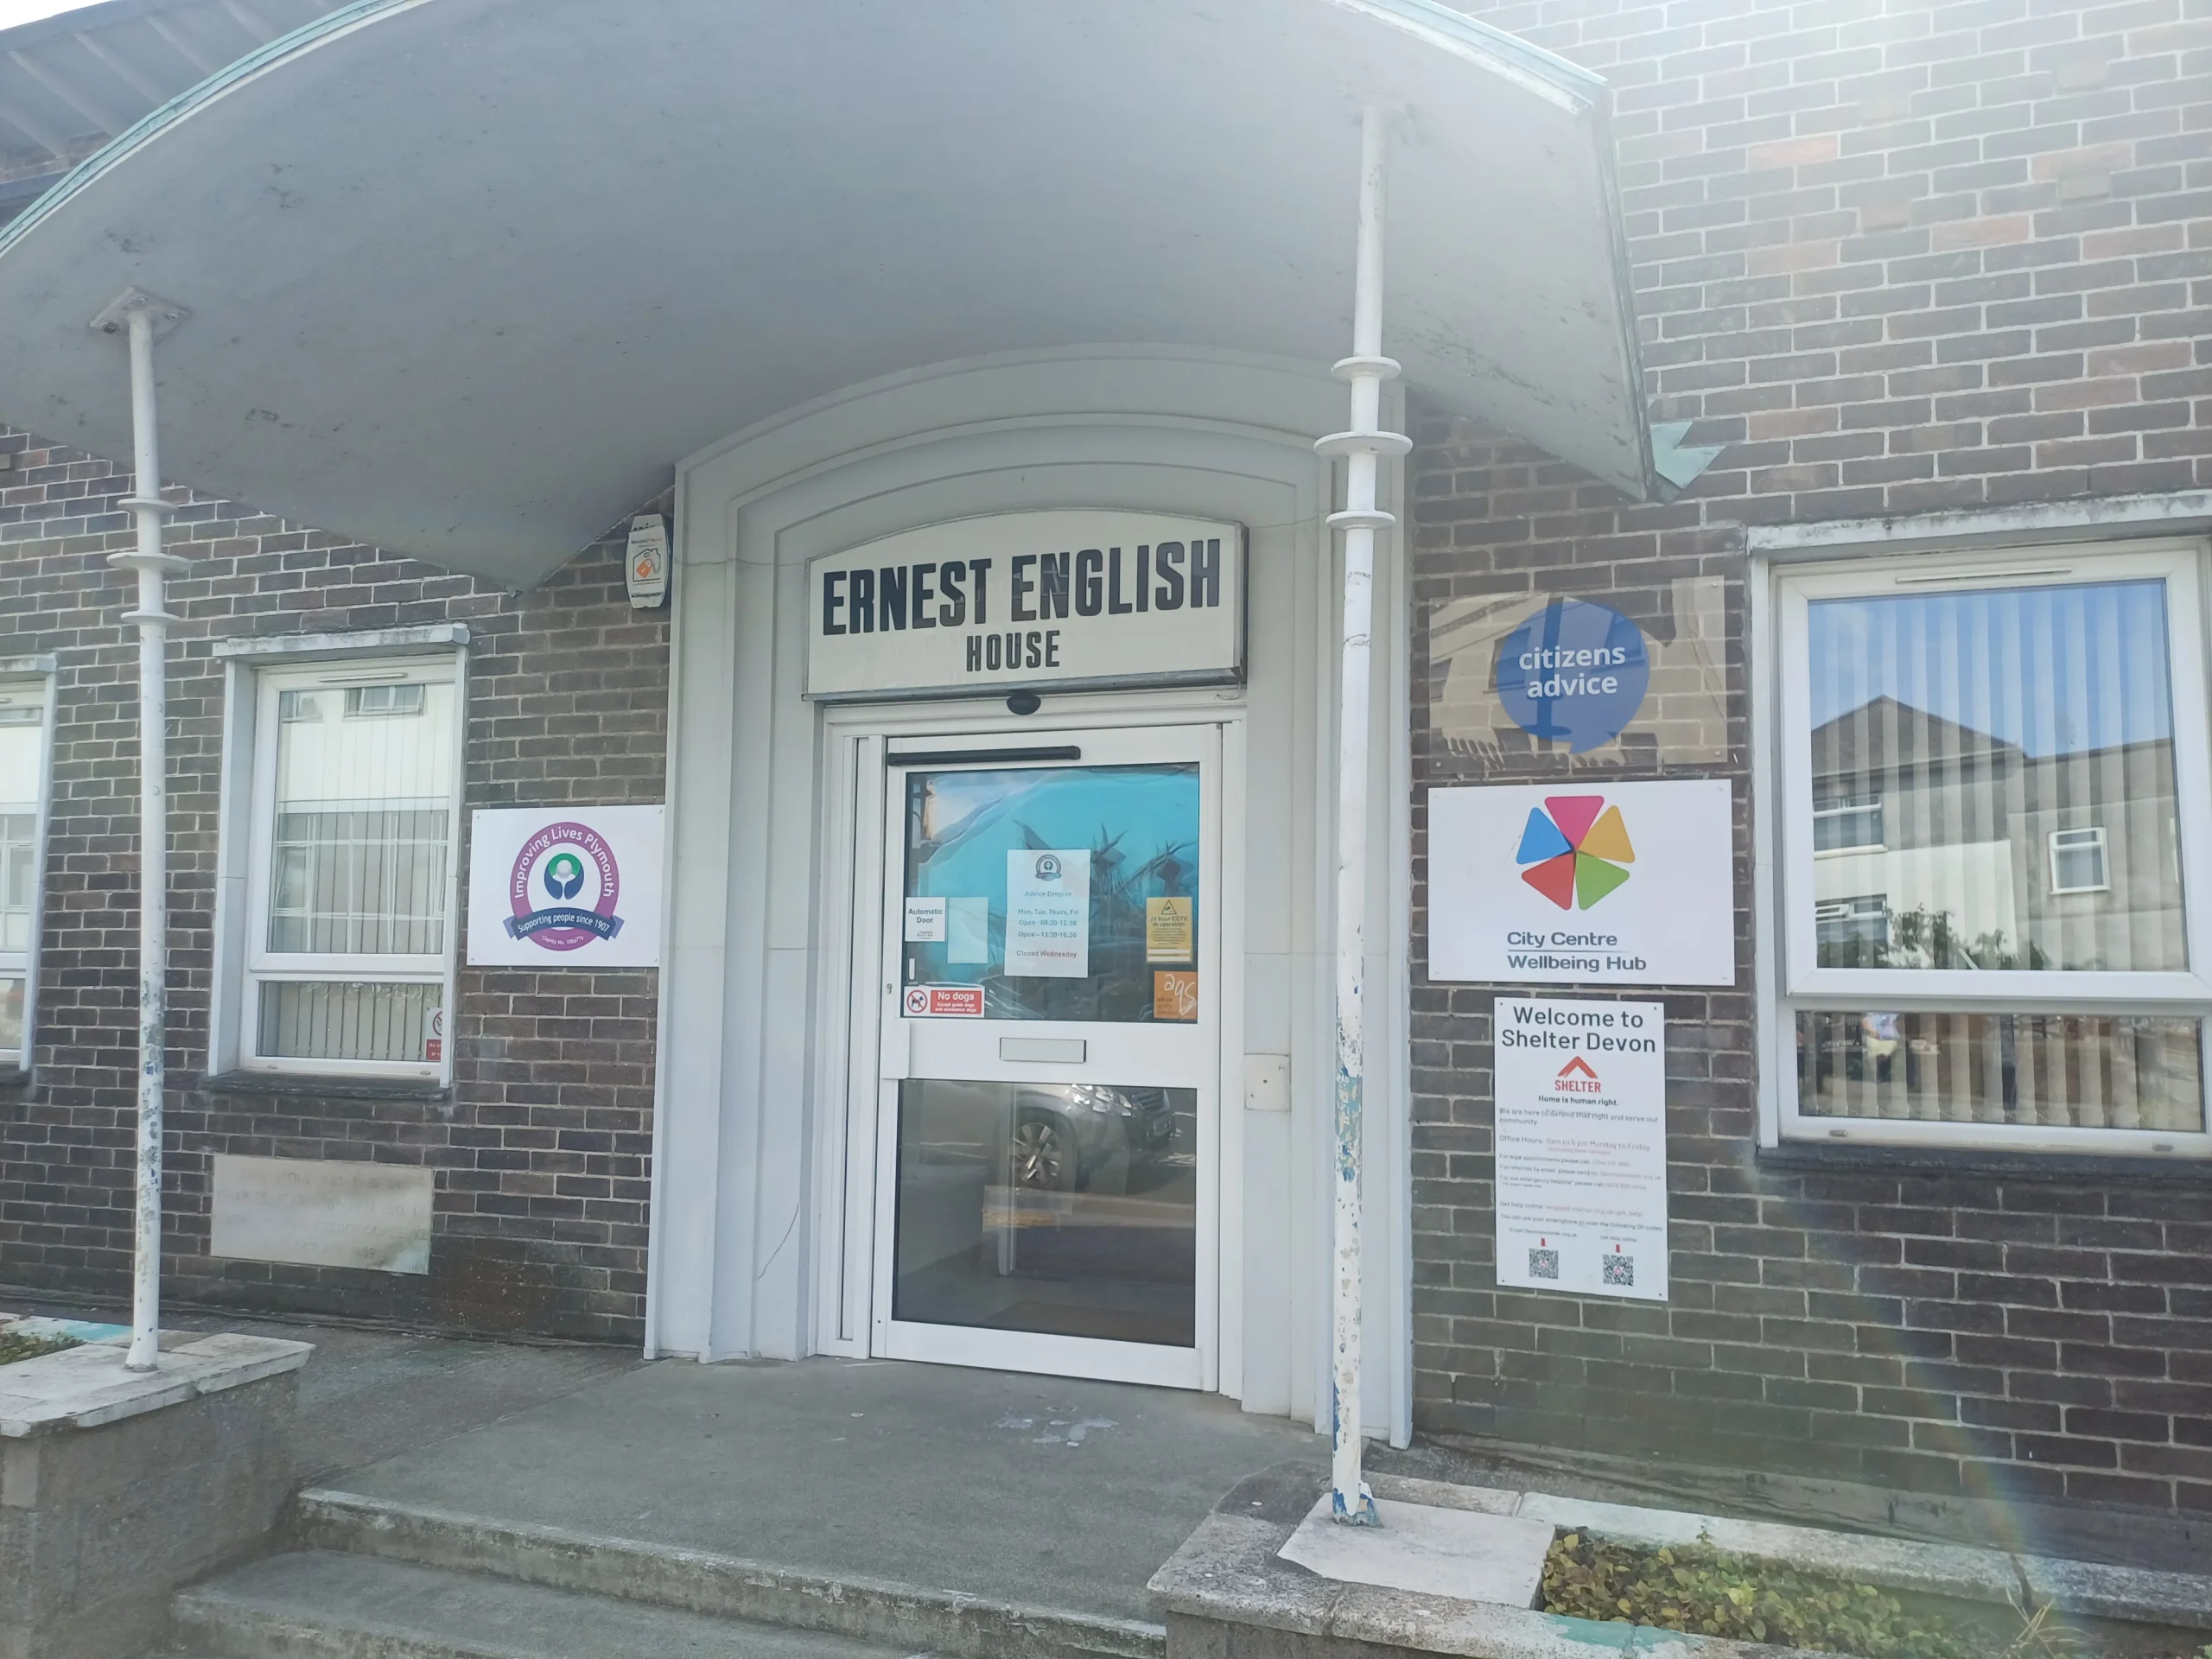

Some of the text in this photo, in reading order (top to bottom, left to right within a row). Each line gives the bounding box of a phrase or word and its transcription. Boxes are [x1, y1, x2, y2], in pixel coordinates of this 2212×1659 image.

[823, 537, 1221, 636] ERNEST ENGLISH
[966, 629, 1061, 672] HOUSE
[1518, 644, 1626, 671] citizens
[1526, 671, 1618, 698] advice
[514, 825, 615, 899] Improving Lives Plymouth
[518, 912, 611, 934] Supporting people since 1907
[1506, 931, 1618, 949] City Centre
[1039, 950, 1077, 958] Wednesday
[1506, 953, 1647, 971] Wellbeing Hub
[938, 992, 975, 1002] No dogs
[1513, 1006, 1644, 1028] Welcome to
[1501, 1029, 1656, 1053] Shelter Devon
[1554, 1078, 1602, 1094] SHELTER
[1538, 1095, 1560, 1103] Home
[1598, 1098, 1619, 1107] right.
[1499, 1116, 1538, 1126] community
[1550, 1109, 1573, 1119] defend
[1575, 1111, 1590, 1120] that
[1592, 1112, 1608, 1121] right
[1499, 1135, 1521, 1143] Office
[1589, 1141, 1618, 1150] Monday
[1627, 1143, 1650, 1152] Friday
